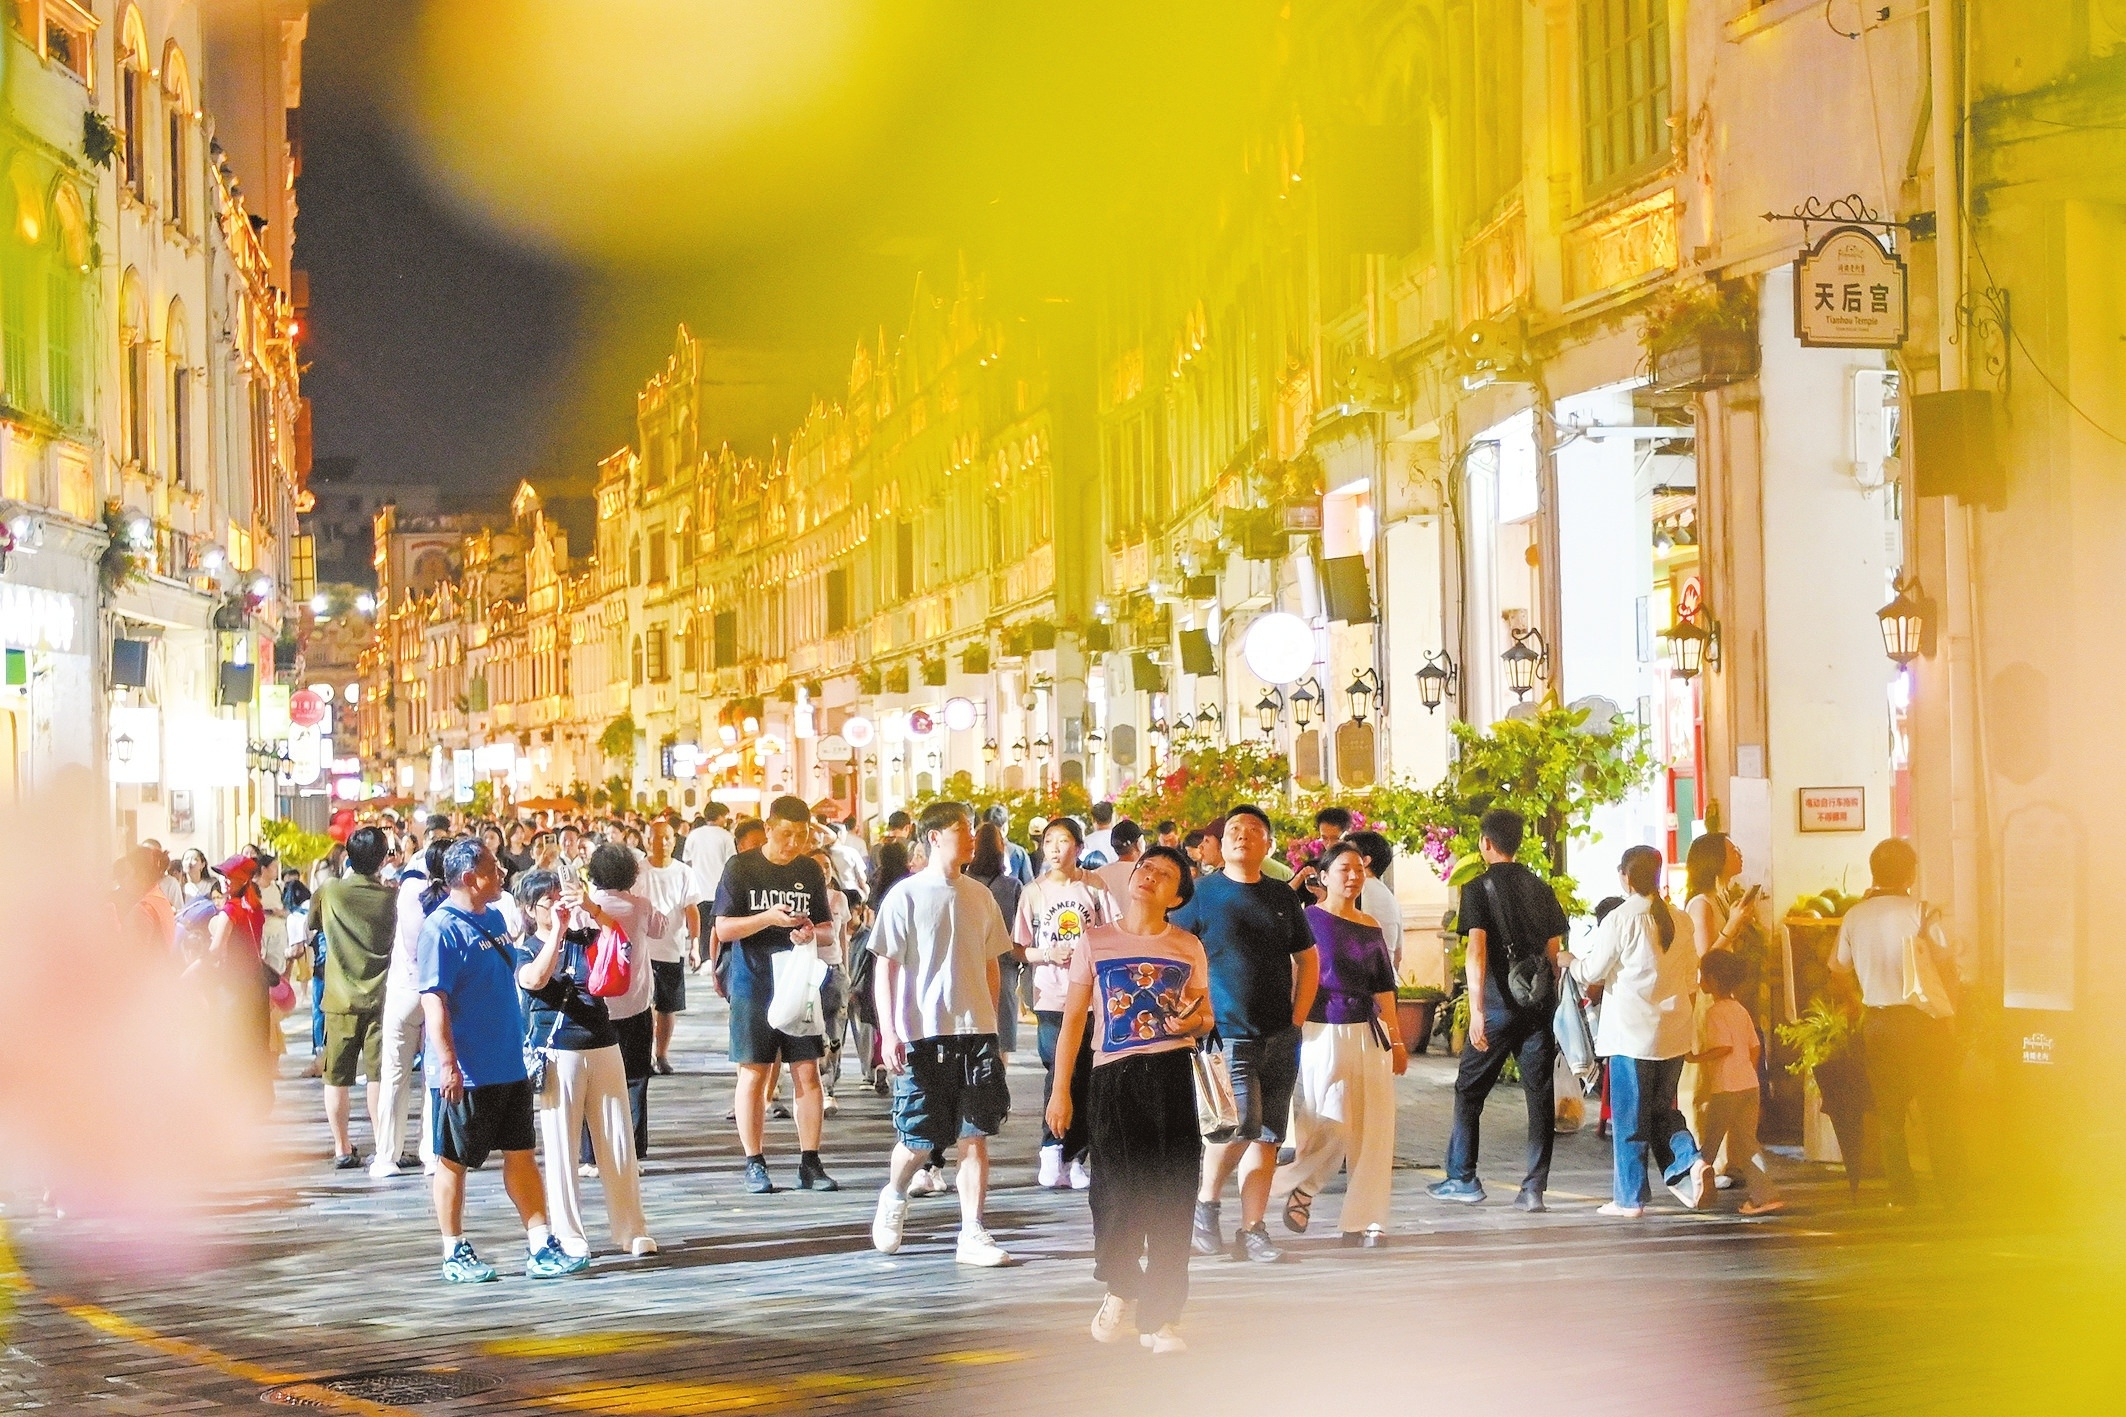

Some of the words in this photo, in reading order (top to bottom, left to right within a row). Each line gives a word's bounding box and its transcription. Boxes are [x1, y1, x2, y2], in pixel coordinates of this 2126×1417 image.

[1815, 283, 1889, 313] 天后宫
[1826, 316, 1853, 325] Tianhou
[1854, 316, 1878, 326] Temple
[749, 889, 811, 913] LACOSTE
[1043, 900, 1076, 927] SUMMER
